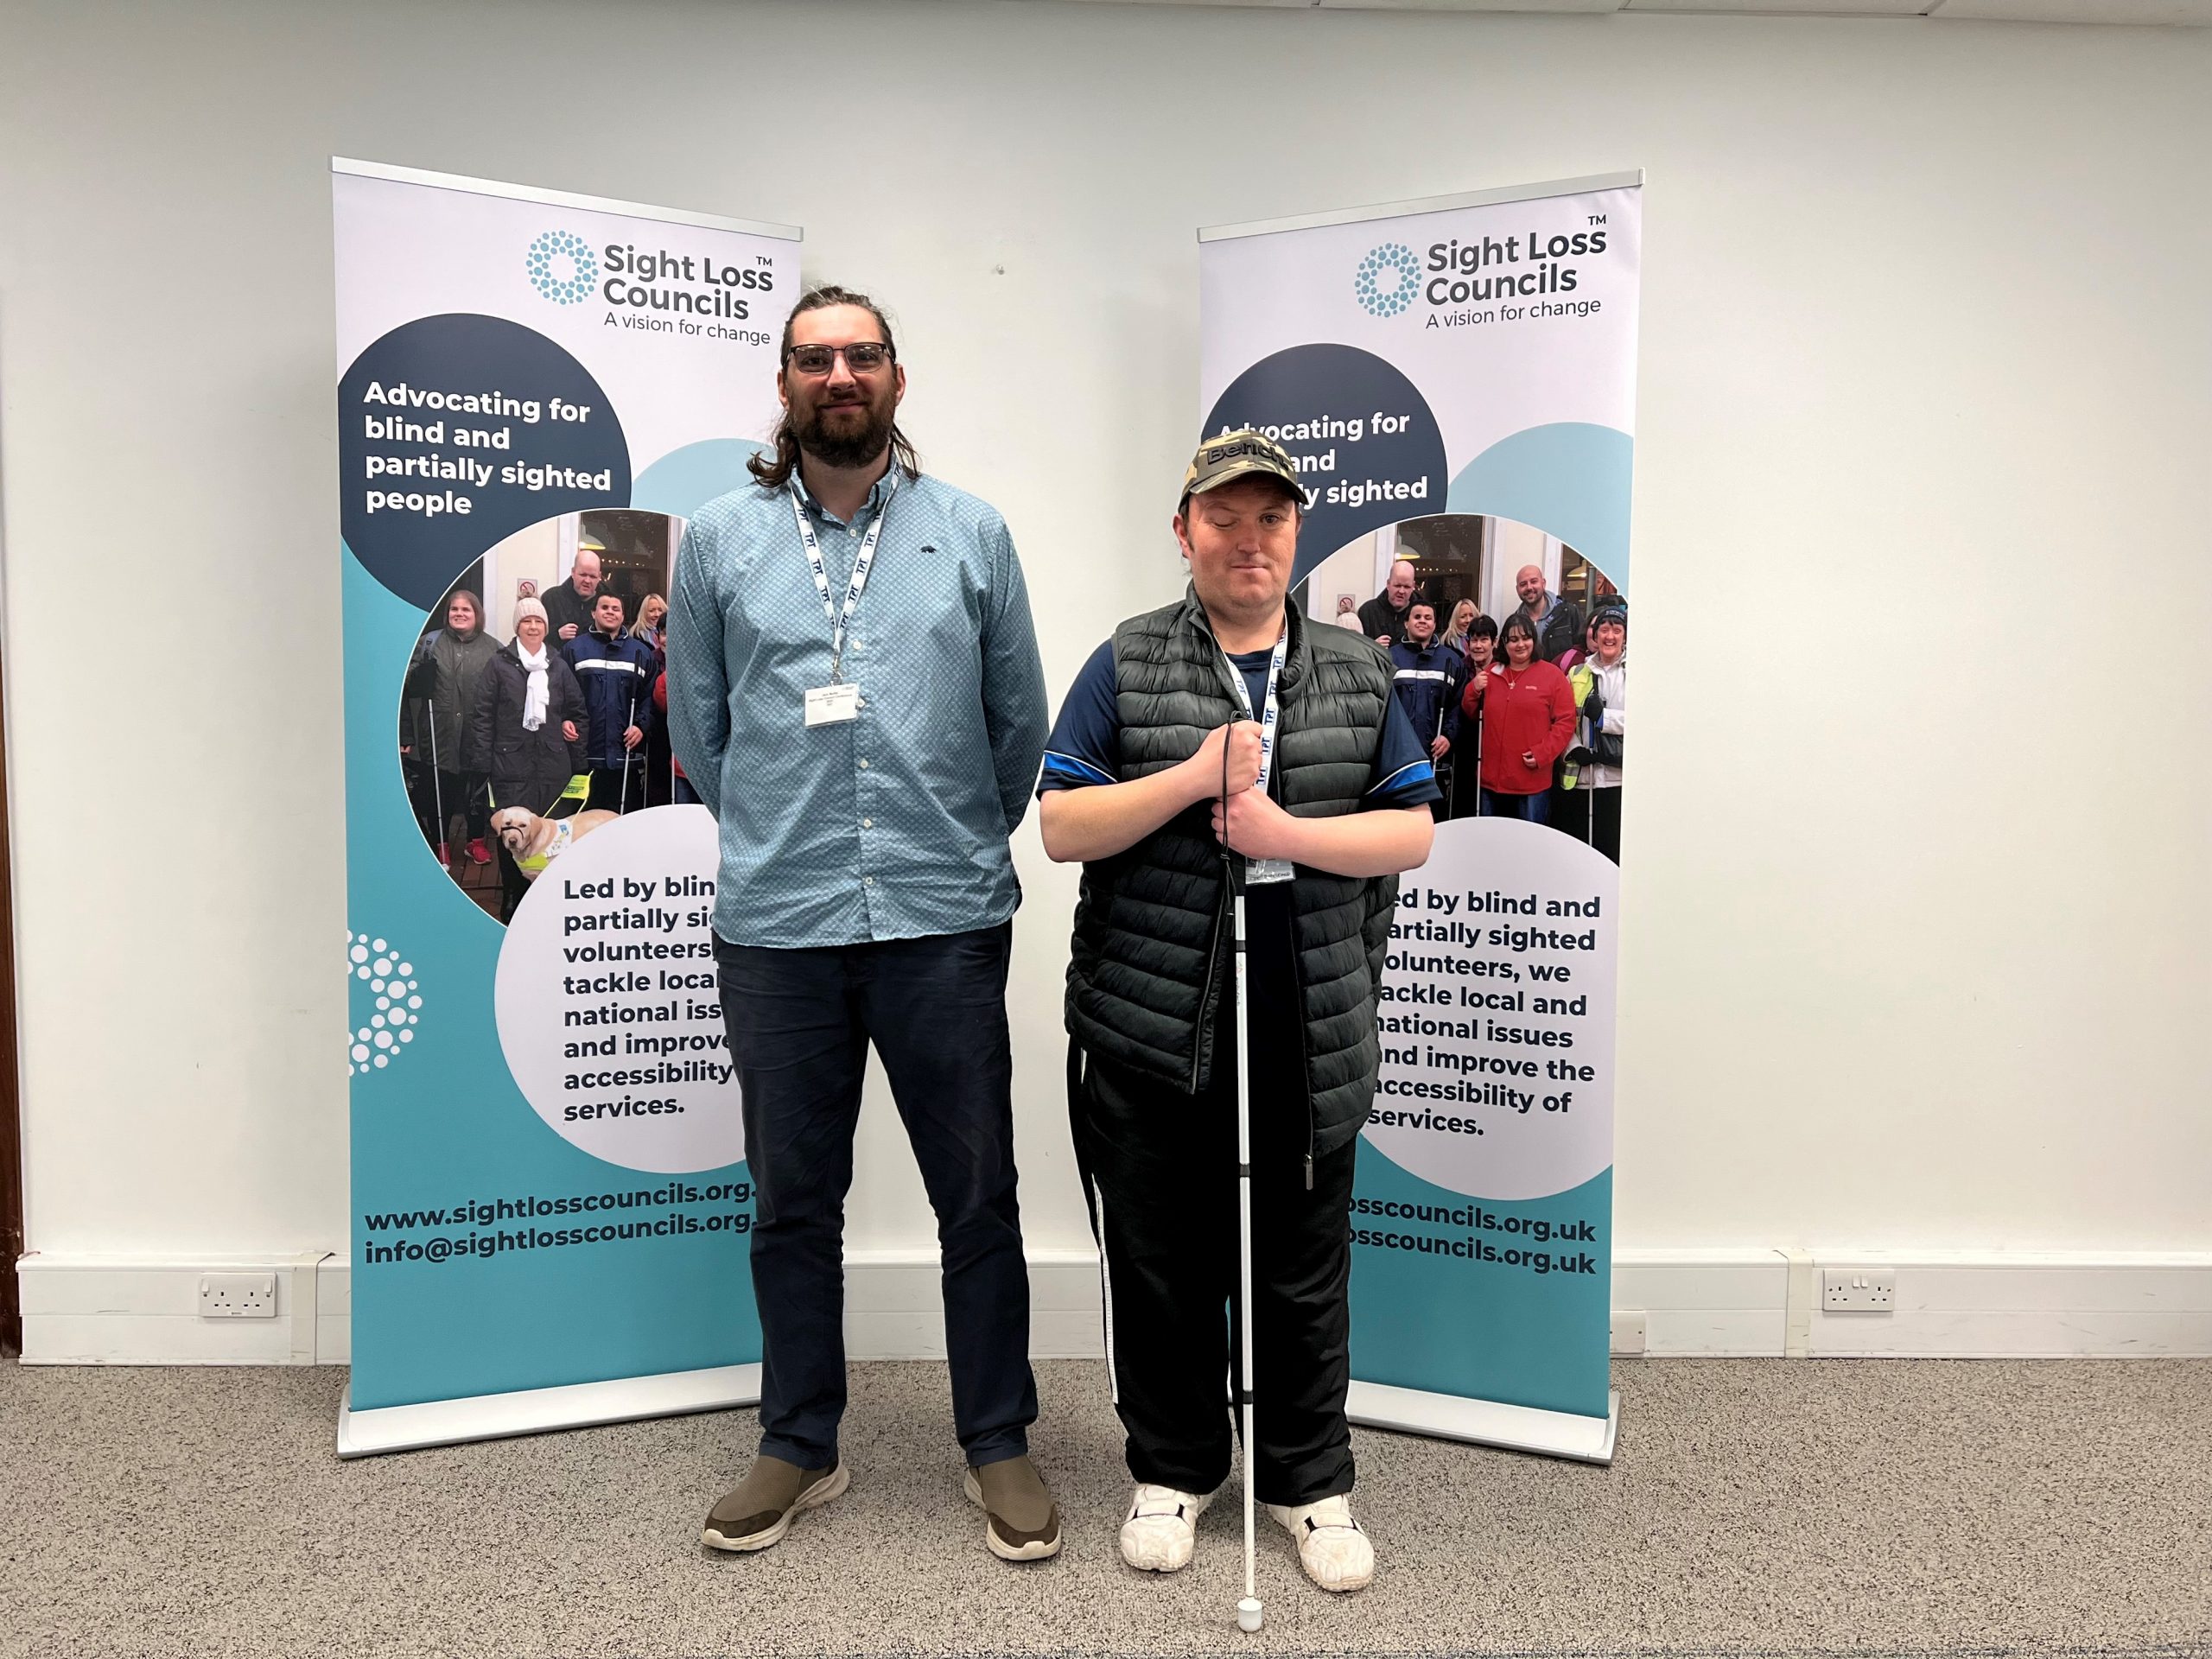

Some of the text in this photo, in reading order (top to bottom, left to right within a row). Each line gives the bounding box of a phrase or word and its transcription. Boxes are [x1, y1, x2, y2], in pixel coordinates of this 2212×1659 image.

[604, 245, 695, 283] Sight
[704, 257, 773, 291] Loss
[1427, 236, 1519, 275] Sight
[1529, 231, 1606, 260] Loss
[604, 278, 749, 320] Councils
[1426, 263, 1577, 305] Councils
[604, 312, 771, 346] A vision for change
[1426, 300, 1601, 329] A vision for change
[363, 381, 590, 423] Advocating for
[365, 415, 510, 449] blind and
[1371, 412, 1410, 435] for
[365, 453, 611, 492] partially sighted
[366, 490, 472, 518] people
[1326, 476, 1427, 507] sighted
[564, 874, 715, 902] Led by blin
[1427, 889, 1459, 915] by
[1468, 891, 1536, 915] blind
[1546, 896, 1600, 918] and
[564, 907, 678, 936] partially
[1388, 918, 1595, 952] artially sighted
[563, 971, 651, 995] tackle
[1384, 951, 1571, 983] olunteers, we
[564, 999, 721, 1027] national iss
[1381, 982, 1586, 1016] ackle local and
[564, 1035, 615, 1058] and
[1487, 1019, 1573, 1047] issues
[564, 1059, 733, 1090] accessibility
[1380, 1046, 1595, 1082] nd improve the
[564, 1095, 685, 1122] services.
[1542, 1092, 1572, 1113] of
[1368, 1108, 1484, 1135] services.
[365, 1180, 757, 1231] www.sightlosscouncils.org.
[1348, 1197, 1597, 1242] osscouncils.org.uk
[365, 1211, 758, 1263] info@sightlosscouncils.org.
[1349, 1228, 1597, 1274] osscouncils.org.uk
